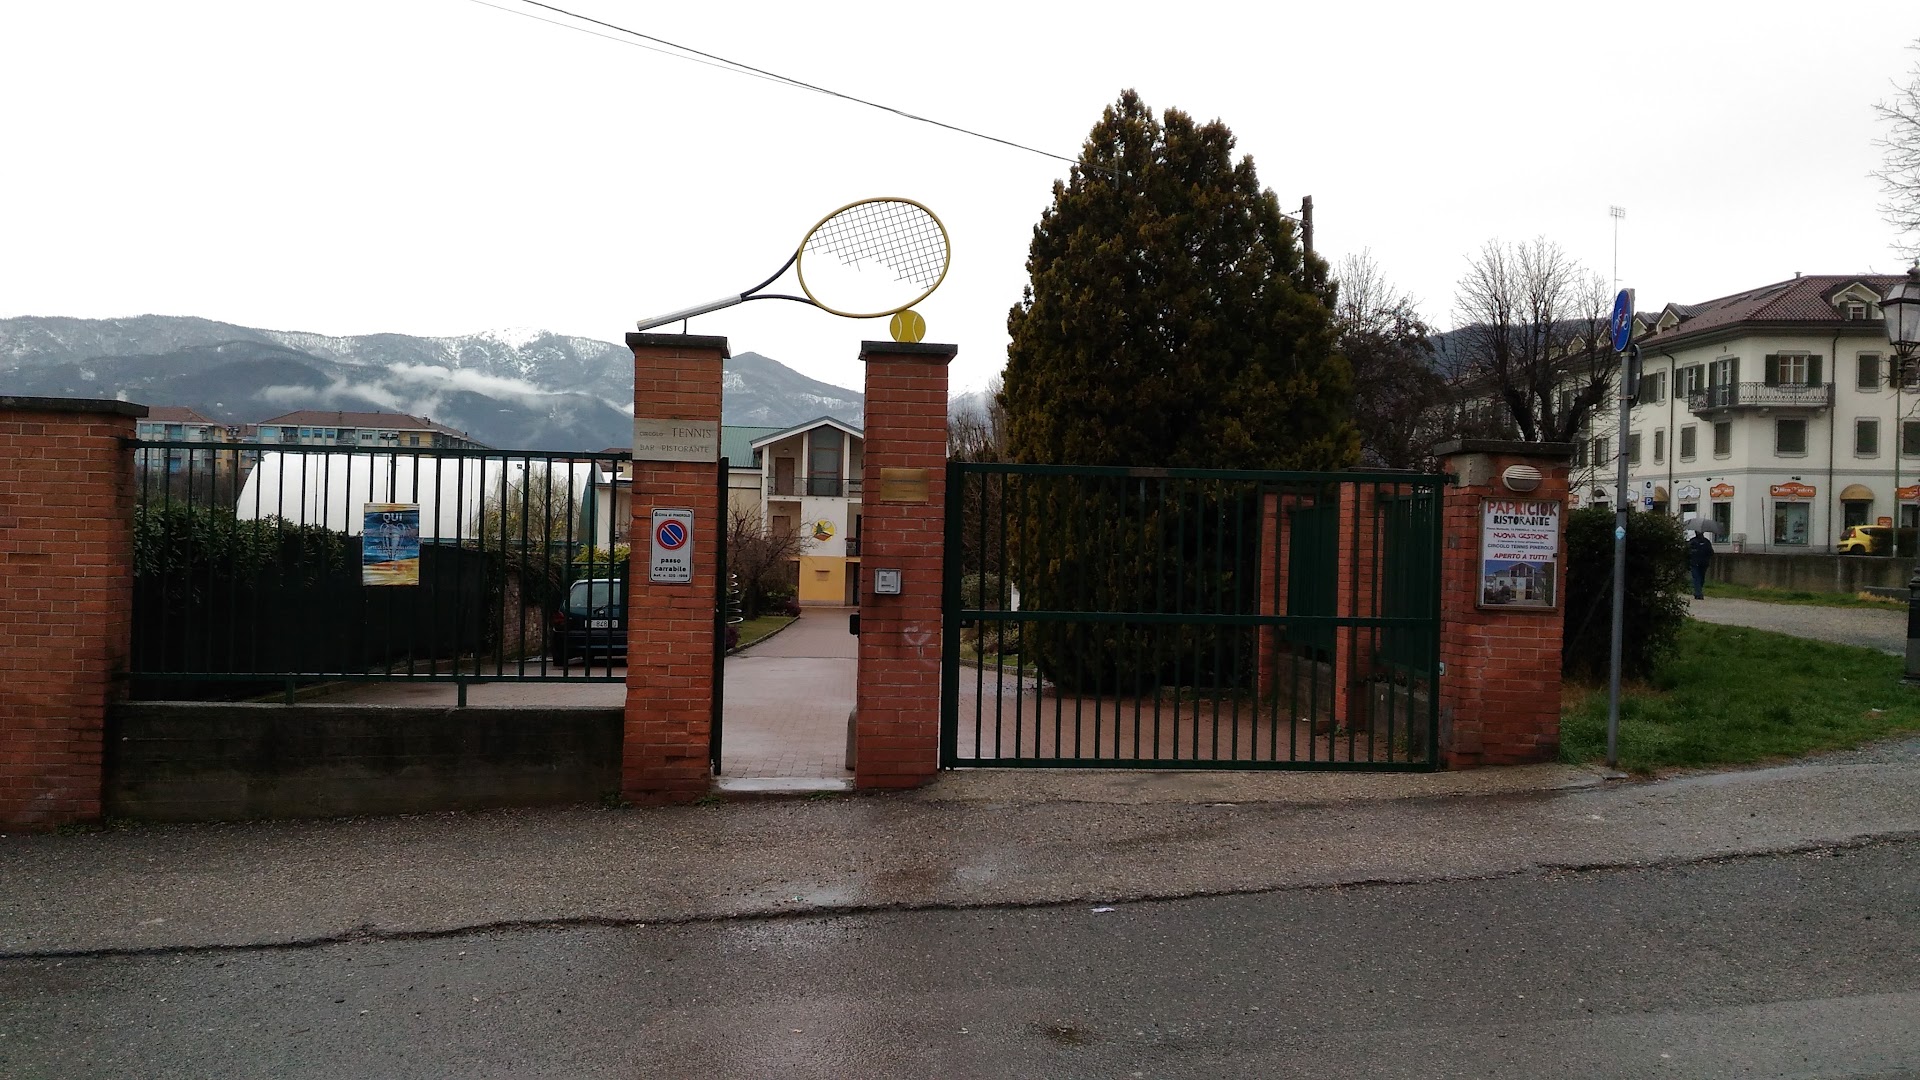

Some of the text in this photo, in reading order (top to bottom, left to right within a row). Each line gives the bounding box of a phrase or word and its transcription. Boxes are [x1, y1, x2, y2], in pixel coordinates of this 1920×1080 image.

[671, 427, 711, 438] TENNIS
[661, 445, 709, 453] RISTORANTE
[1493, 515, 1550, 526] RISTORANTE
